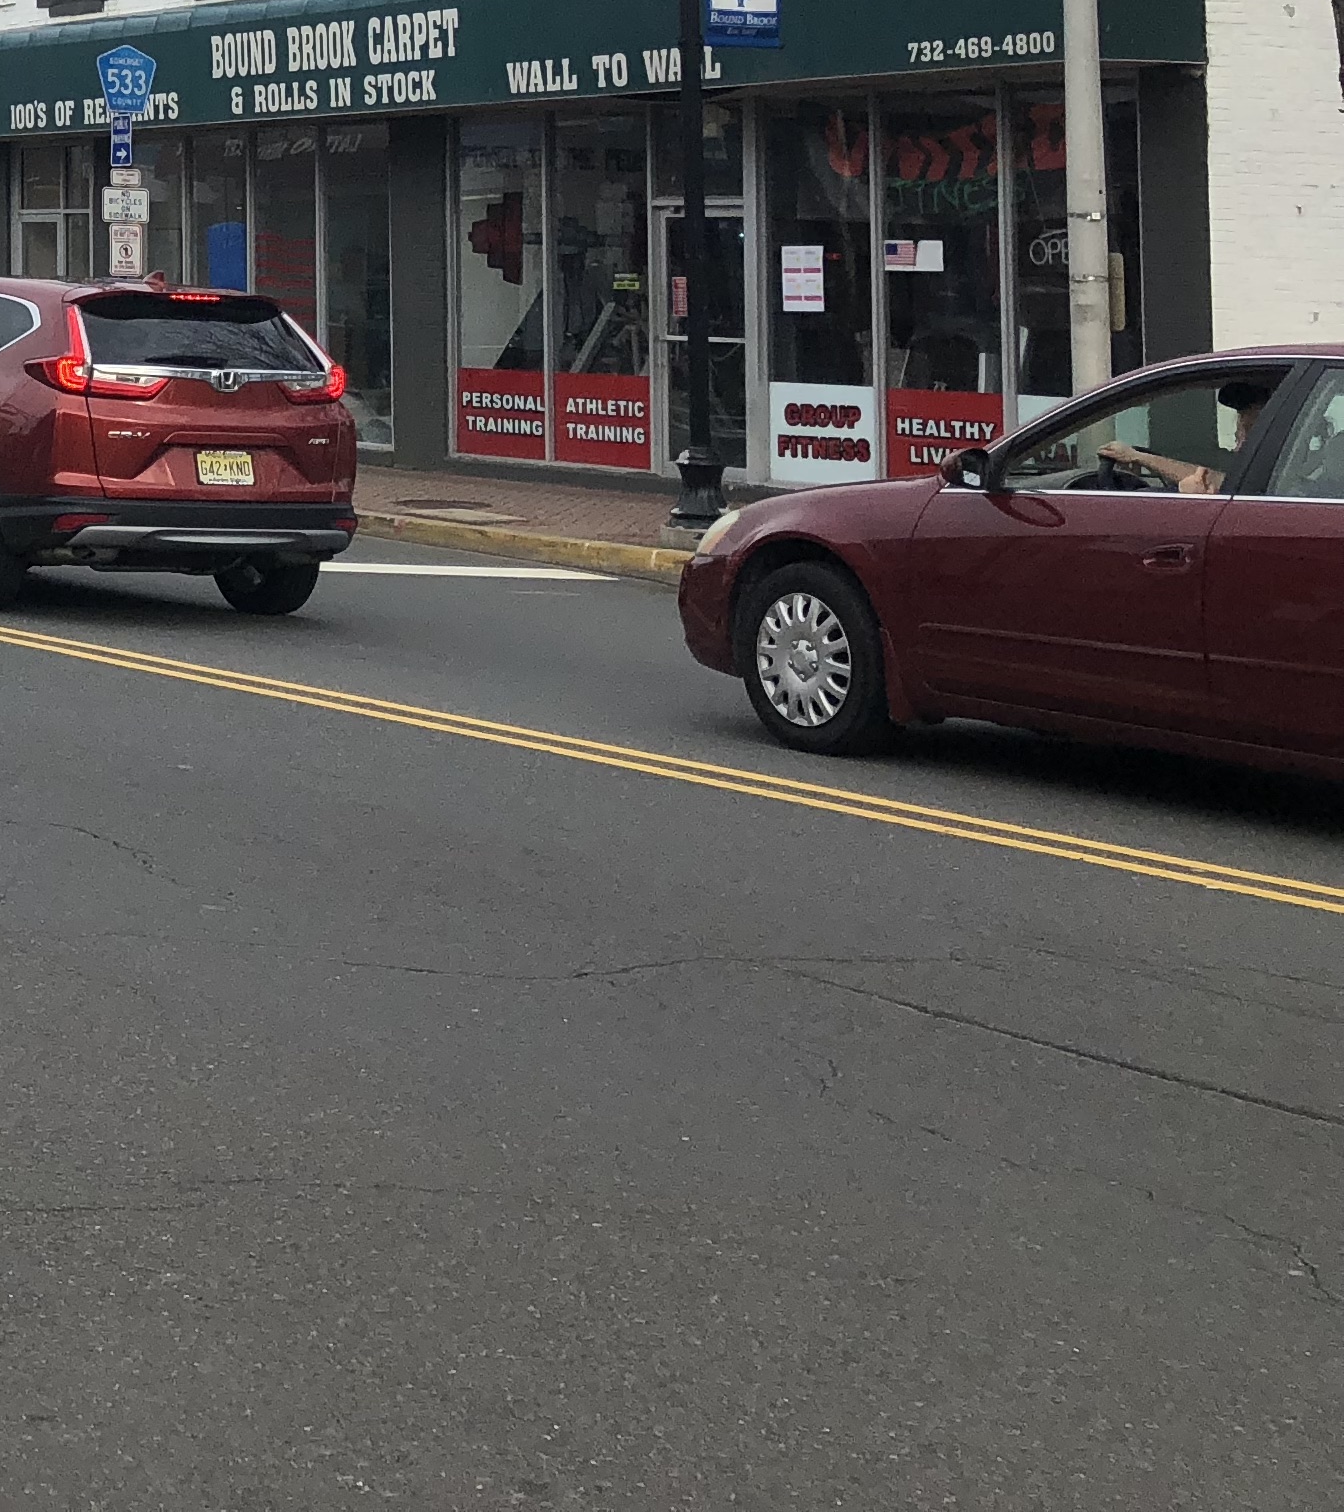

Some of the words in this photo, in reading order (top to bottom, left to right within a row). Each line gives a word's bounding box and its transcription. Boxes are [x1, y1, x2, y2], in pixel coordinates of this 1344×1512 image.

[210, 29, 277, 79] BOUND
[287, 20, 357, 72] BROOK
[367, 8, 459, 64] CARPET
[907, 31, 1055, 63] 732-469-4800
[506, 58, 578, 93] WALL
[592, 52, 628, 88] TO
[642, 45, 721, 84] WAL
[107, 69, 146, 96] 533
[231, 90, 243, 114] &
[254, 80, 317, 113] ROLLS
[329, 78, 352, 108] IN
[364, 70, 437, 104] STOCK
[10, 100, 47, 130] 100'S
[55, 100, 75, 127] OF
[108, 197, 143, 206] BICYCLES
[108, 211, 143, 220] SIDEWALK
[462, 391, 545, 412] PERSONAL
[566, 397, 645, 418] ATHLETIC
[465, 415, 543, 436] TRAINING
[784, 402, 861, 429] GROUP
[107, 431, 151, 439] CR-V
[566, 423, 645, 444] TRAINING
[896, 417, 995, 440] HEALTHY
[777, 434, 871, 463] FITNESS
